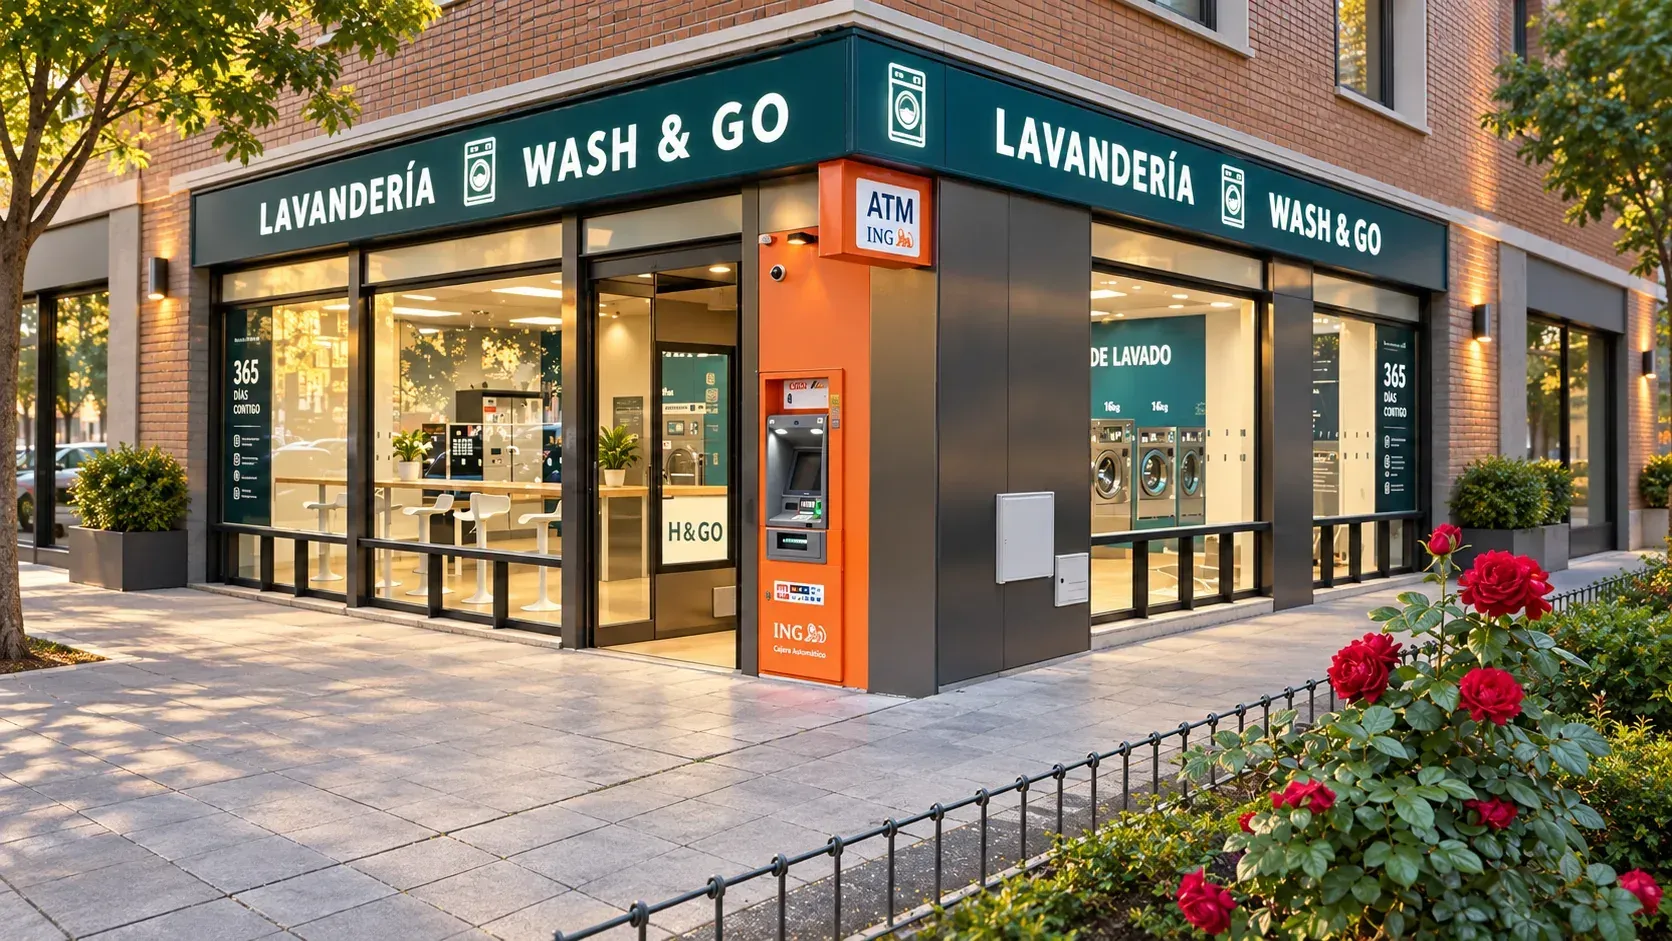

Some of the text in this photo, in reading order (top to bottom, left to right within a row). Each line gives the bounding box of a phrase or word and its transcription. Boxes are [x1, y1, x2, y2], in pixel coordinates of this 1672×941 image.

[522, 92, 790, 188] WASH & GO
[996, 107, 1195, 206] LAVANDERÍA
[259, 159, 436, 236] LAVANDERÍA
[866, 190, 914, 225] ATM
[866, 226, 894, 246] ING
[1268, 192, 1382, 256] WASH & GO
[1091, 344, 1172, 367] DE LAVADO
[233, 359, 260, 385] 365
[1383, 362, 1407, 389] 365
[233, 388, 249, 401] DÍAS
[1383, 391, 1397, 404] DÍAS
[233, 403, 261, 415] CONTIGO
[1383, 406, 1407, 418] CONTIGO
[773, 622, 803, 641] ING
